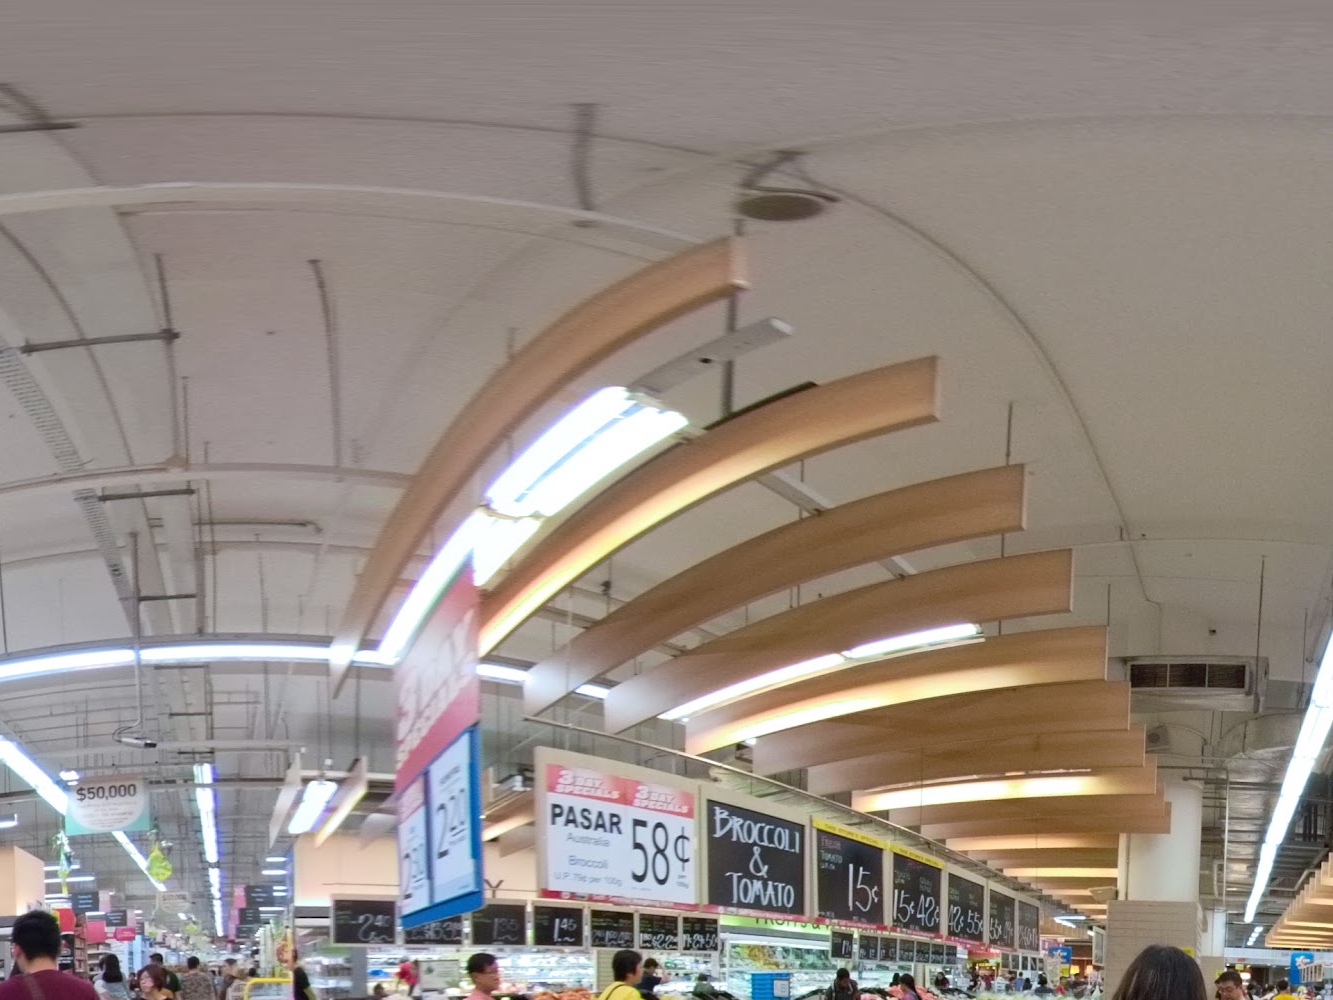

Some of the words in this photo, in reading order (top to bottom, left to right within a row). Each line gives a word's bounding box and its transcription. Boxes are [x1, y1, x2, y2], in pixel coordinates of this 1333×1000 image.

[76, 784, 137, 802] $50,000
[555, 784, 620, 799] SPECIALS
[633, 798, 689, 814] SPECIALS
[551, 803, 623, 835] PASAR
[713, 806, 800, 853] BROCCOLI
[566, 833, 611, 848] Australia
[568, 855, 610, 869] Broccoli
[749, 846, 769, 878] &
[725, 872, 795, 908] TOMATO
